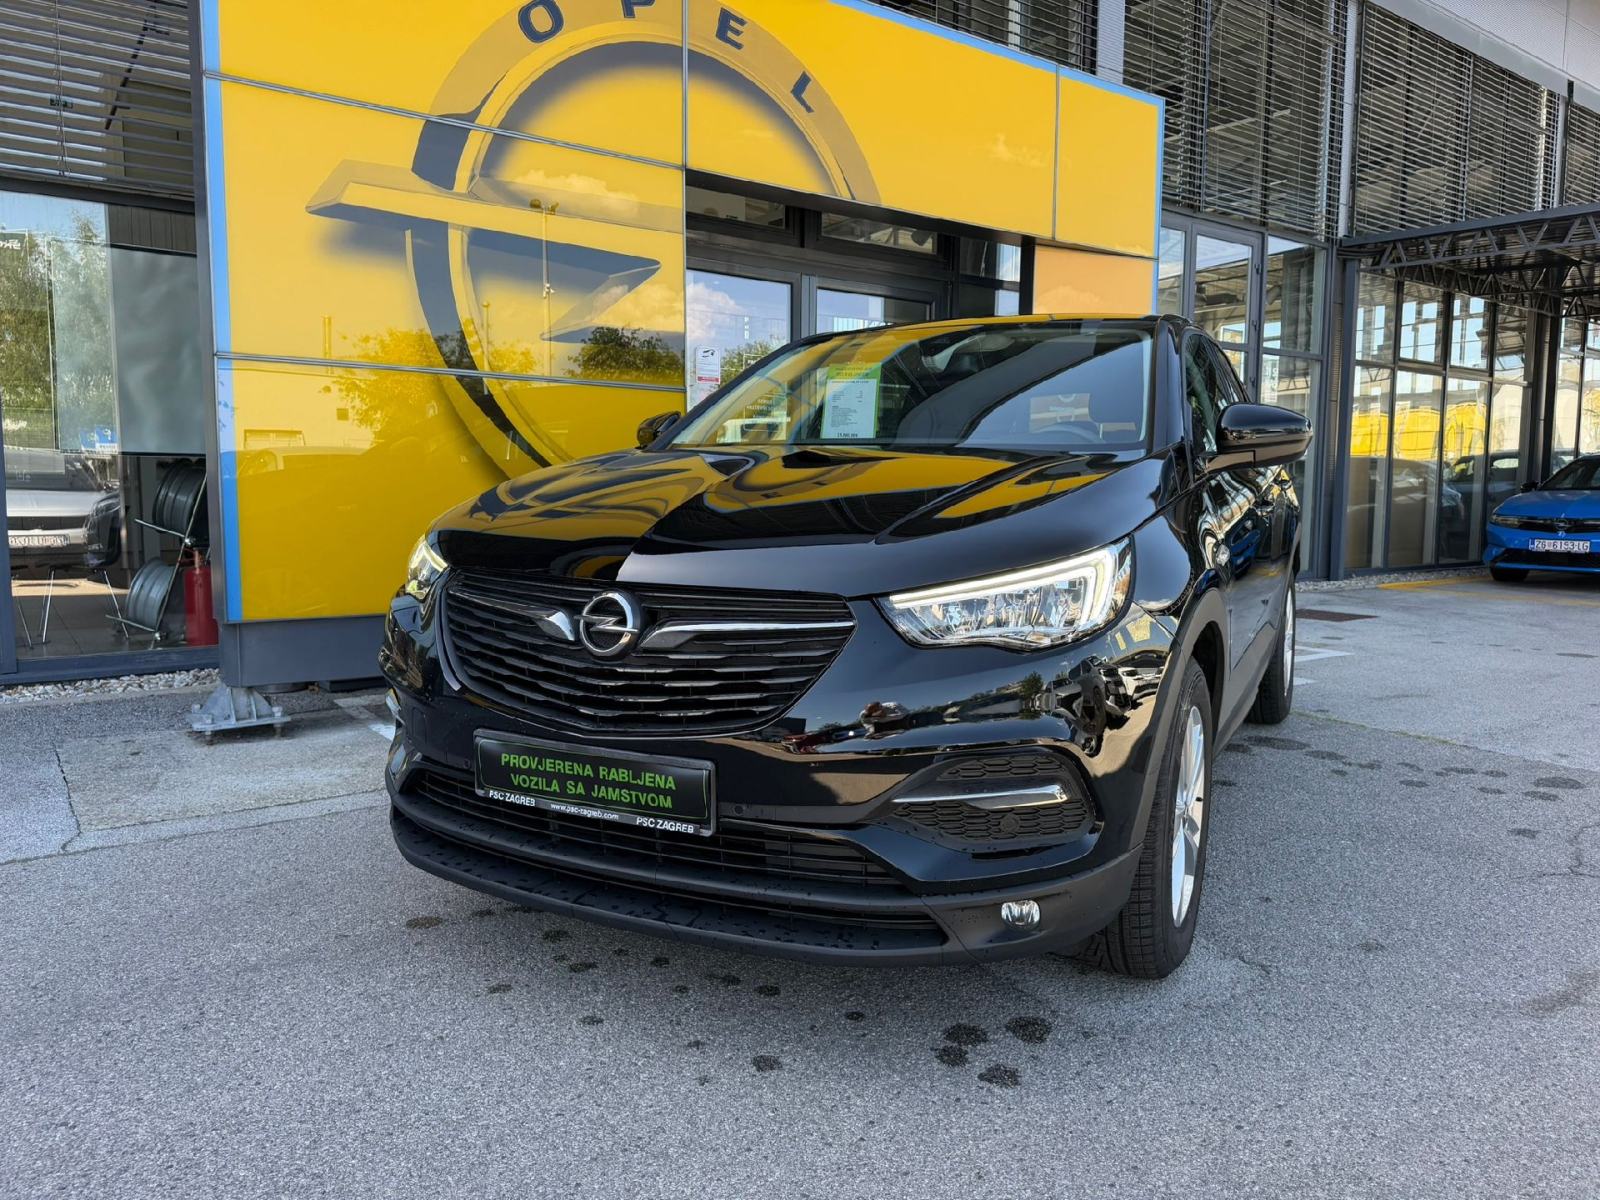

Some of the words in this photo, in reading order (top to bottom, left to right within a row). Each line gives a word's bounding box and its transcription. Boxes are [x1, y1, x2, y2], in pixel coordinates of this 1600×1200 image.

[518, 0, 815, 114] OPEL
[501, 753, 594, 778] PROVJERENA
[599, 766, 677, 790] RABLJENA
[489, 790, 505, 801] PSC
[505, 793, 536, 807] ZAGREB
[510, 773, 560, 793] VOZILA
[566, 780, 586, 796] SA
[591, 784, 673, 809] JAMSTVOM
[550, 803, 620, 820] www.psc-zagreb.com
[636, 816, 656, 828] PSC
[656, 820, 695, 835] ZAGREB
